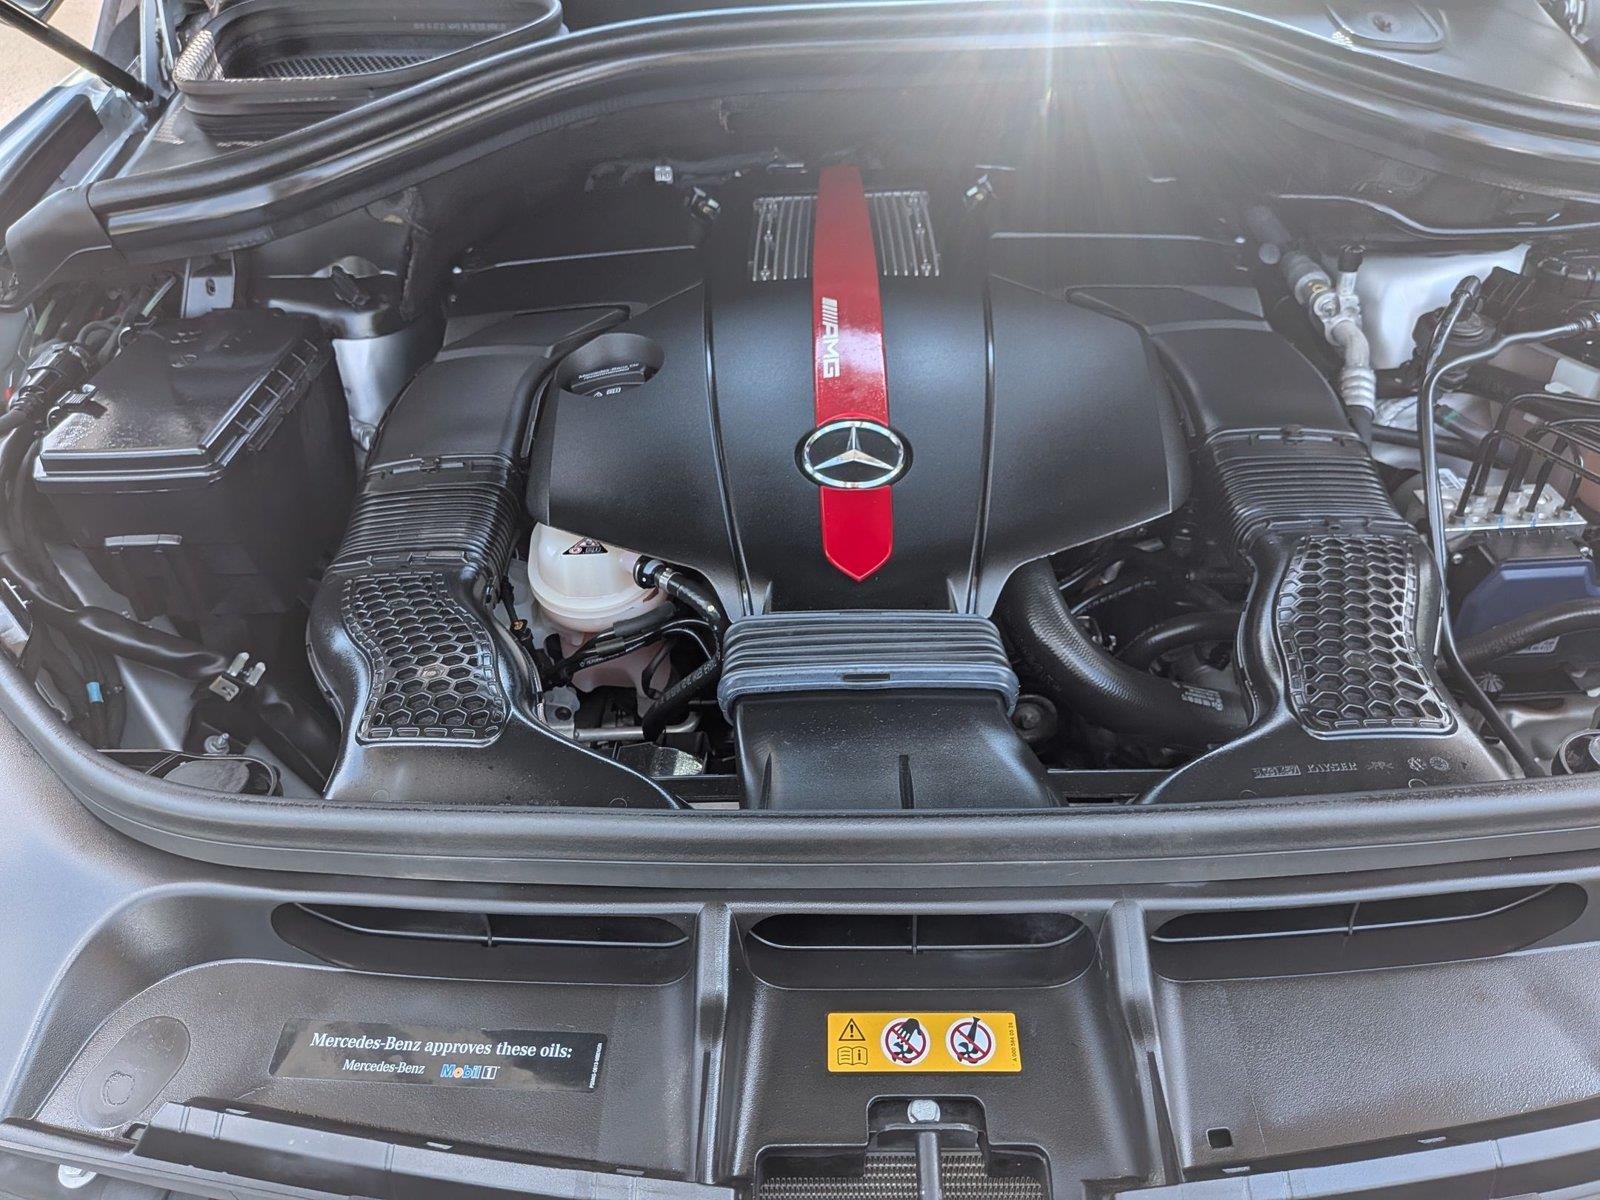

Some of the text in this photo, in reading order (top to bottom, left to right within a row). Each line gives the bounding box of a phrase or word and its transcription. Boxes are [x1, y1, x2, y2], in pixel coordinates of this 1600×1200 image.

[822, 321, 840, 379] AMG
[310, 1032, 573, 1059] Mercedes-Benz approves these oils:
[342, 1059, 426, 1075] Mercedes-Benz
[439, 1063, 481, 1079] Mobil
